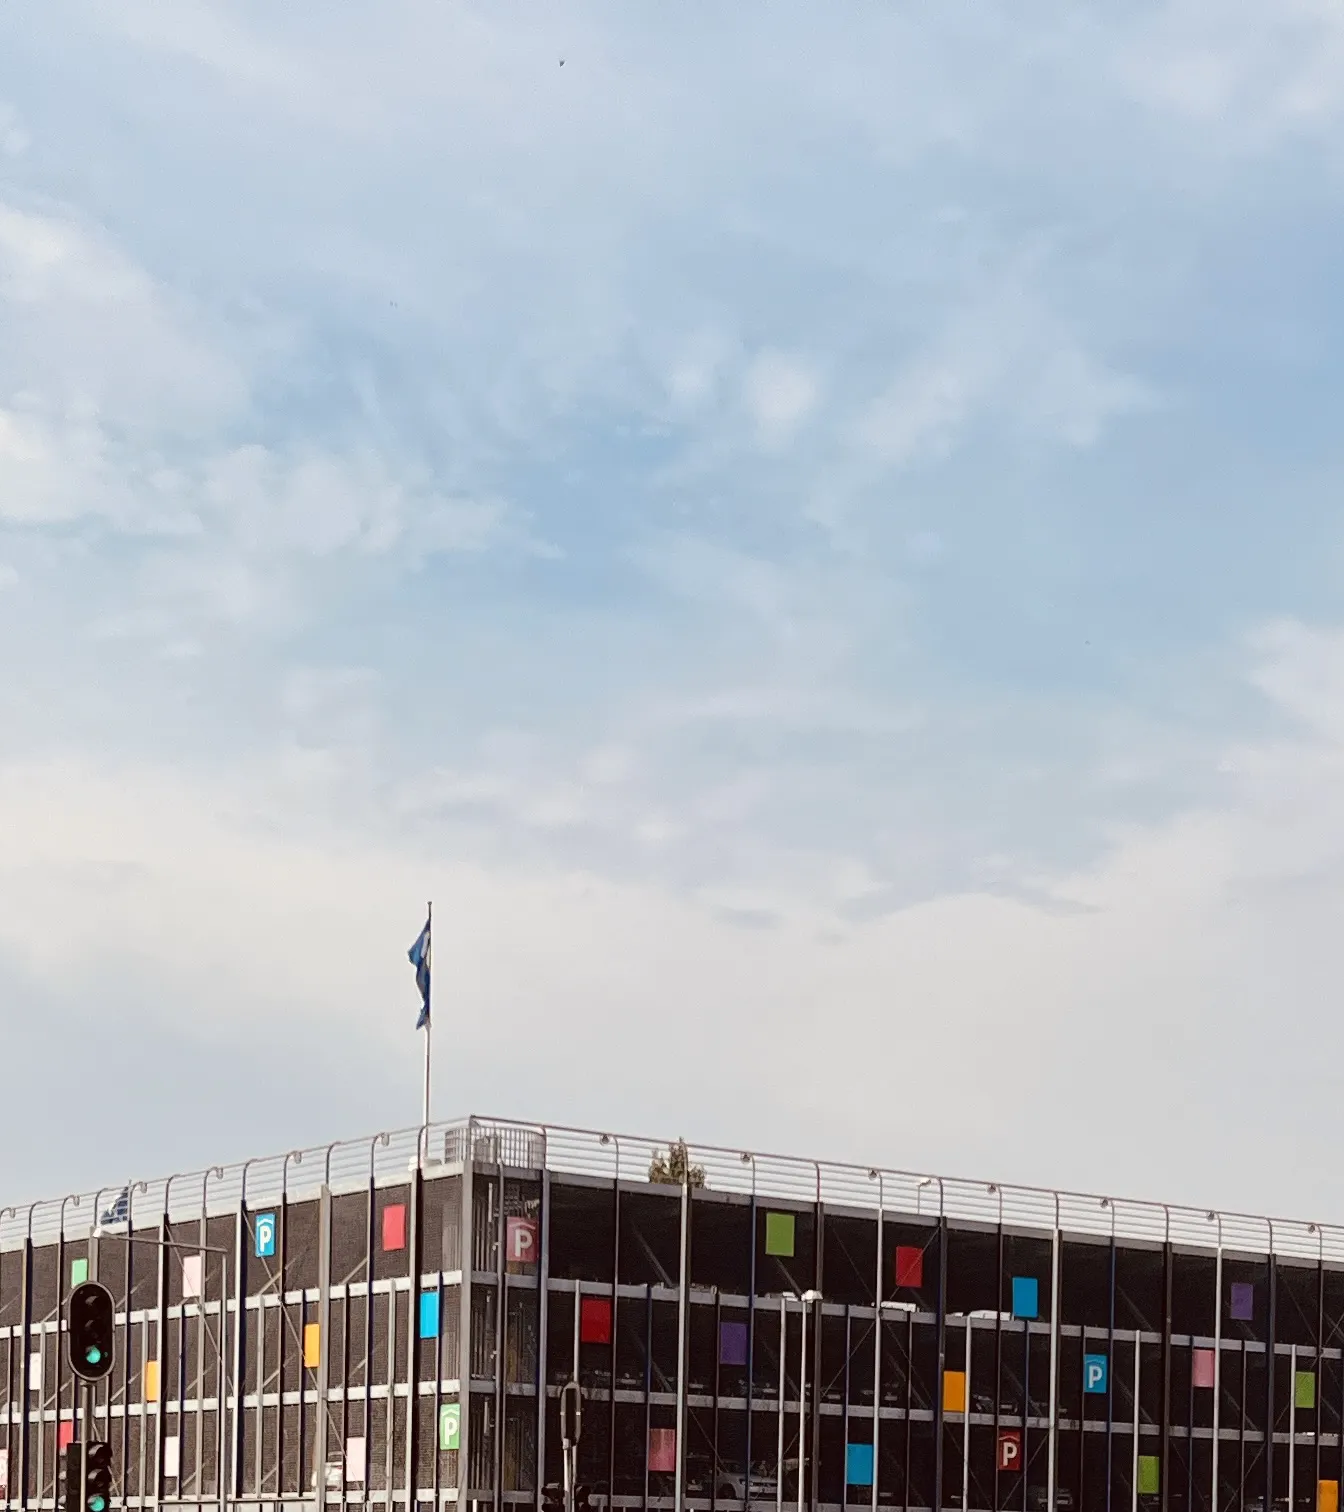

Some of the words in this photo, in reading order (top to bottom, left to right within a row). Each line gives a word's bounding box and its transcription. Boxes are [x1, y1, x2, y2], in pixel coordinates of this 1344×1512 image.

[259, 1225, 272, 1252] P
[515, 1229, 533, 1257] P
[1088, 1365, 1103, 1389] P
[444, 1416, 458, 1445] P
[1002, 1441, 1018, 1467] P
